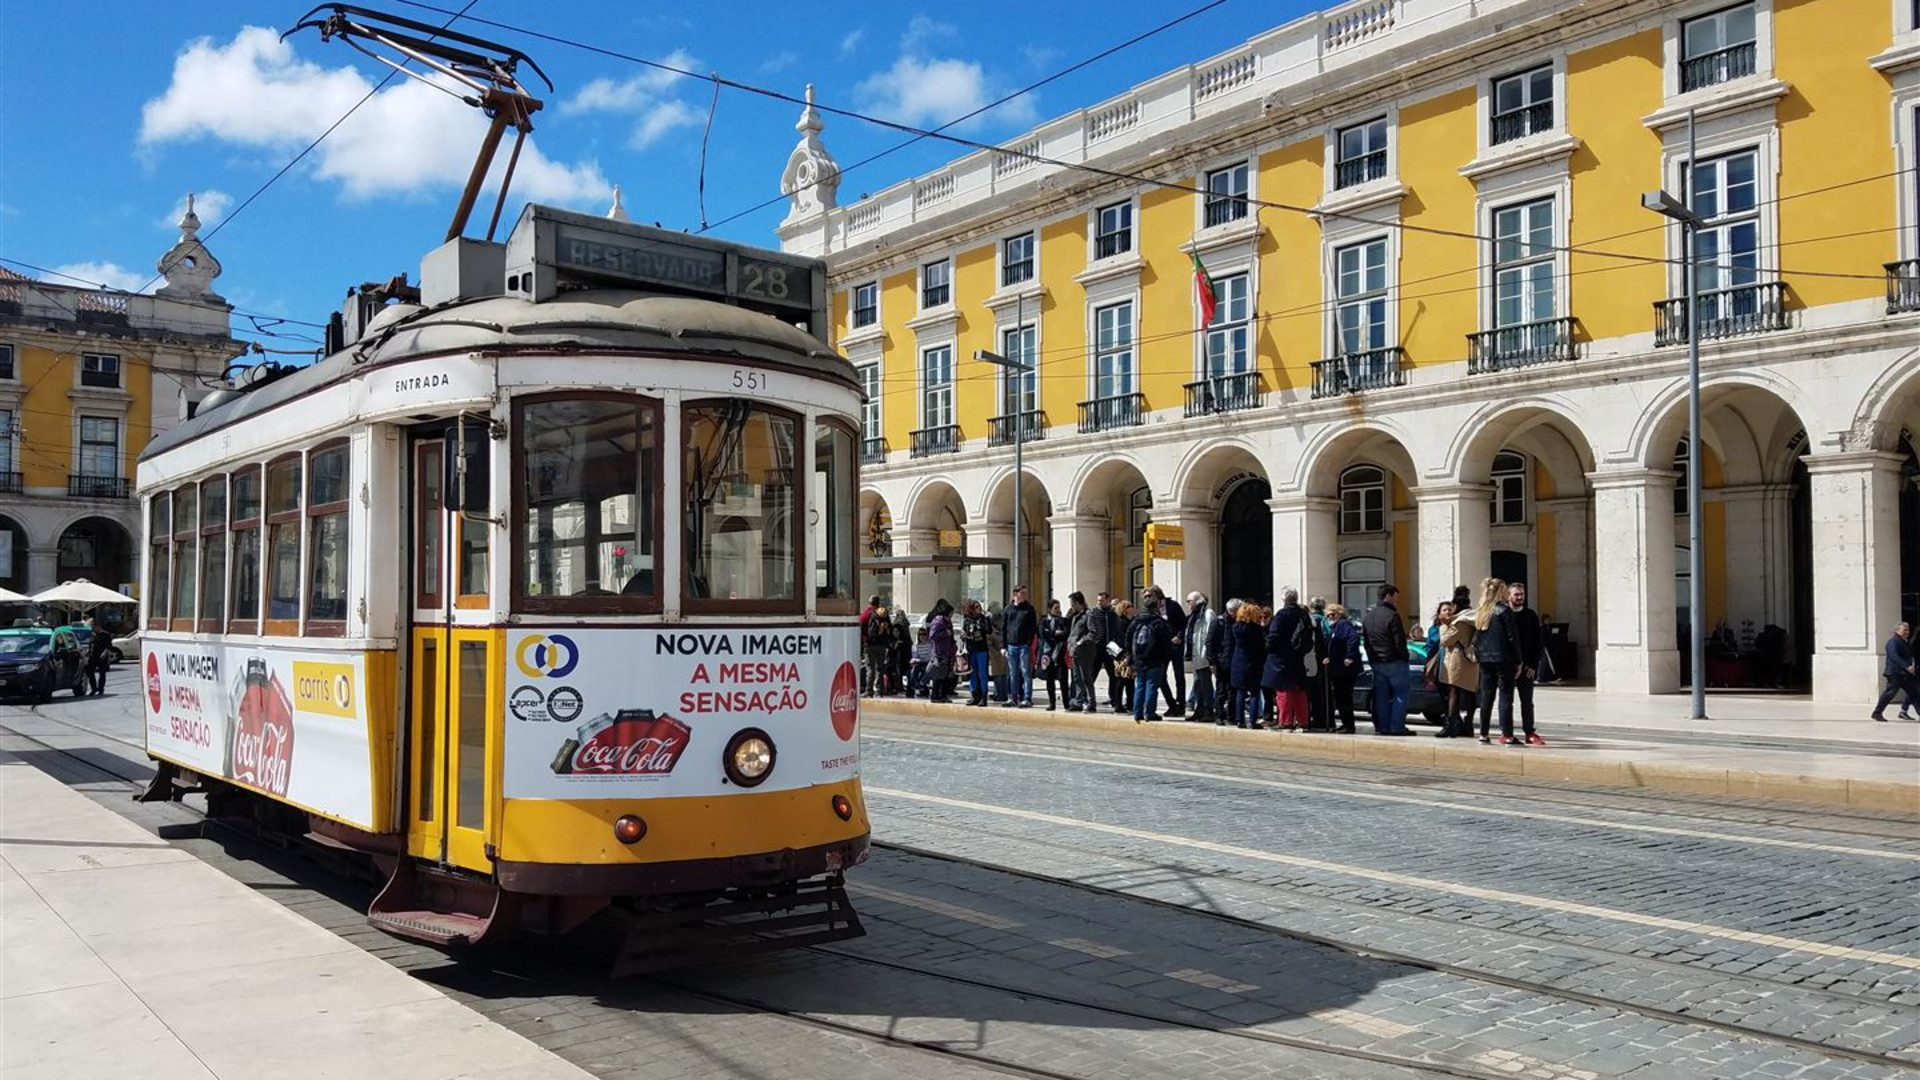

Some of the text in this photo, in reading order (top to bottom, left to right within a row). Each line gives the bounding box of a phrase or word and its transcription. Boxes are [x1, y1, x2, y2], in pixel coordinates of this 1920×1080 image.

[570, 239, 789, 300] RESERVADO 28
[395, 373, 449, 392] ENTRADA
[732, 370, 766, 390] 551
[656, 634, 822, 655] NOVA IMAGEM
[165, 653, 219, 682] NOVA IMAGEM
[690, 662, 801, 684] A MESMA
[168, 684, 202, 713] A MESMA
[299, 669, 330, 701] carris
[679, 685, 808, 714] SENSAÇÃO
[170, 715, 212, 749] SENSAÇÃO
[572, 738, 681, 772] Coca-Cola
[821, 758, 839, 770] TASTE
